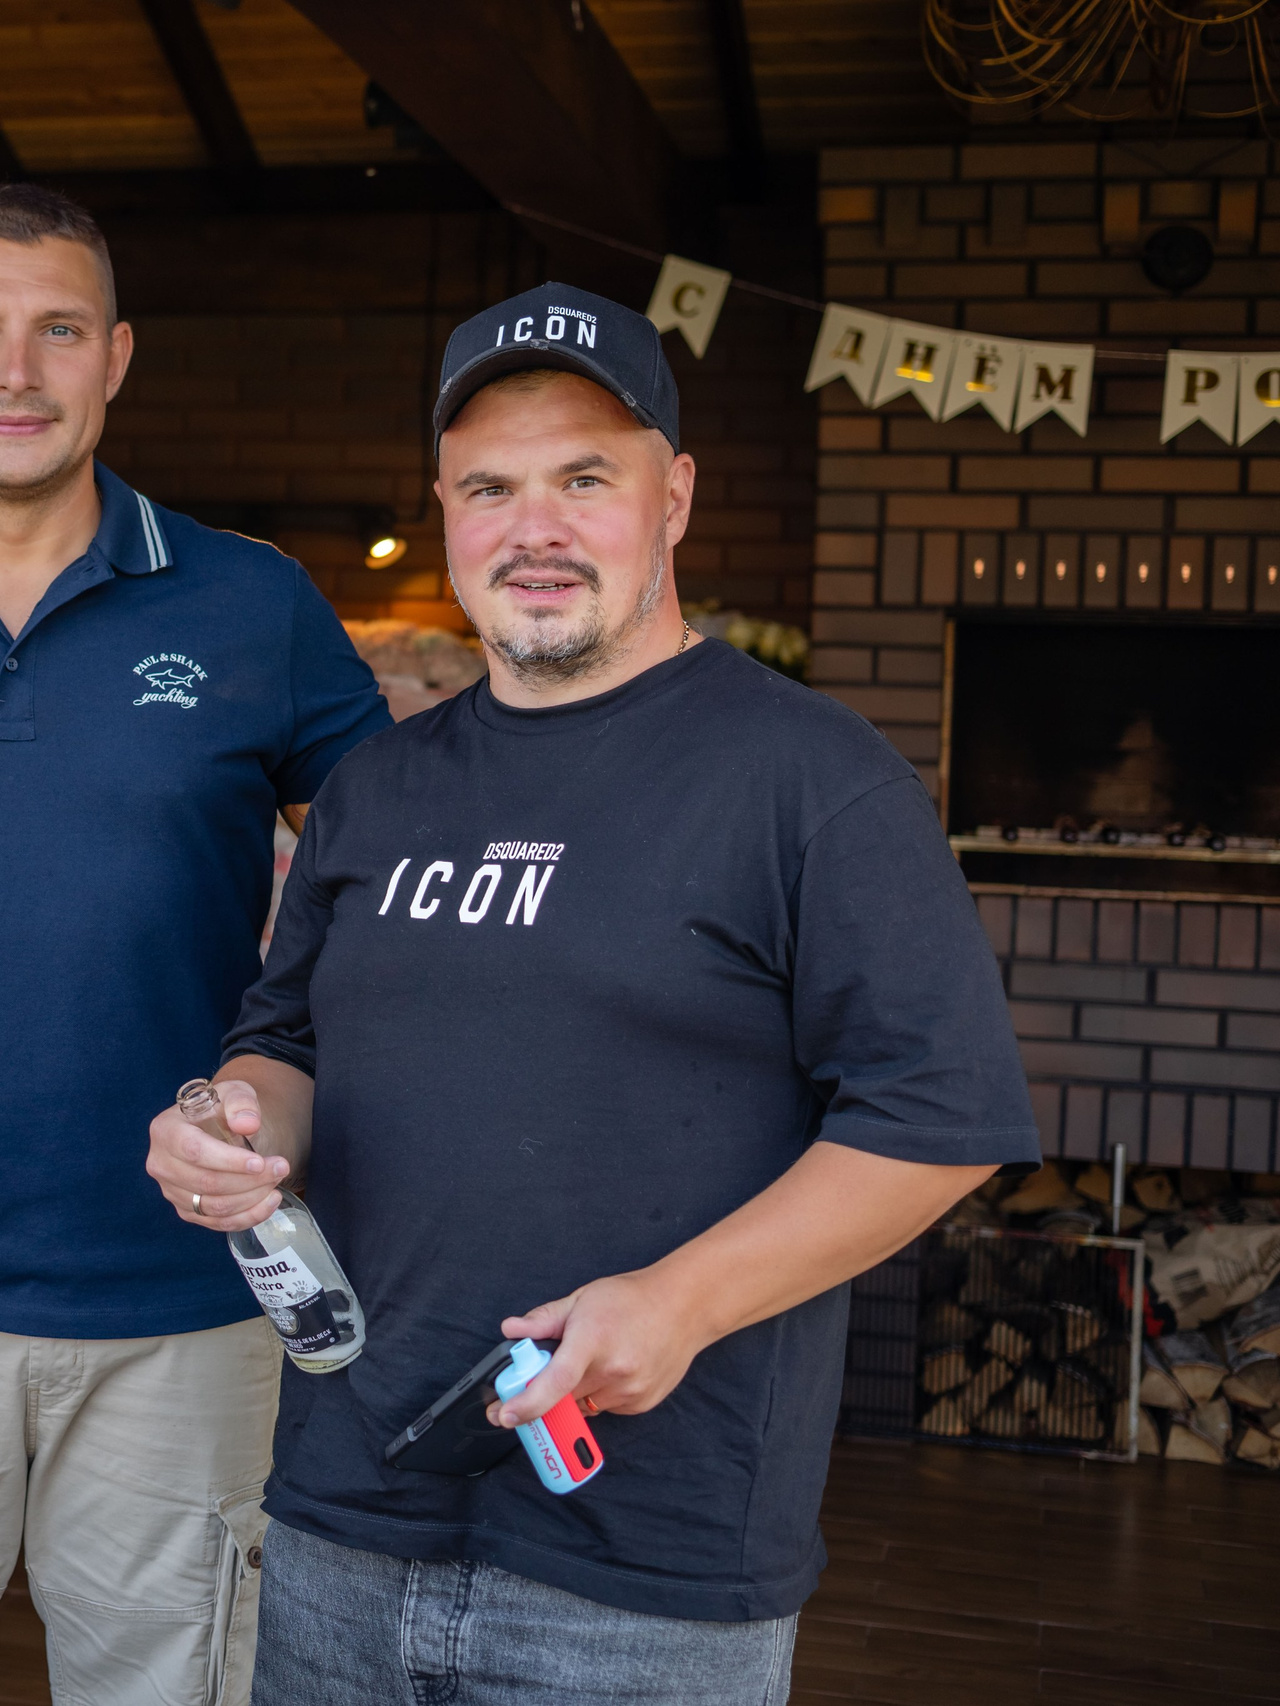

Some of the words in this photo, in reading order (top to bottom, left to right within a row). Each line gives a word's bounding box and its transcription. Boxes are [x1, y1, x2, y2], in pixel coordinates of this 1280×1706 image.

[547, 305, 597, 325] DSQUARED2
[495, 315, 597, 349] ICON
[830, 326, 1077, 403] ДНЁМ
[132, 655, 159, 676] PAUL
[159, 652, 169, 662] &
[169, 653, 208, 681] SHARK
[132, 687, 199, 709] yachting
[482, 840, 565, 861] DSQUARED2
[377, 858, 556, 926] ICON
[238, 1260, 291, 1279] orona
